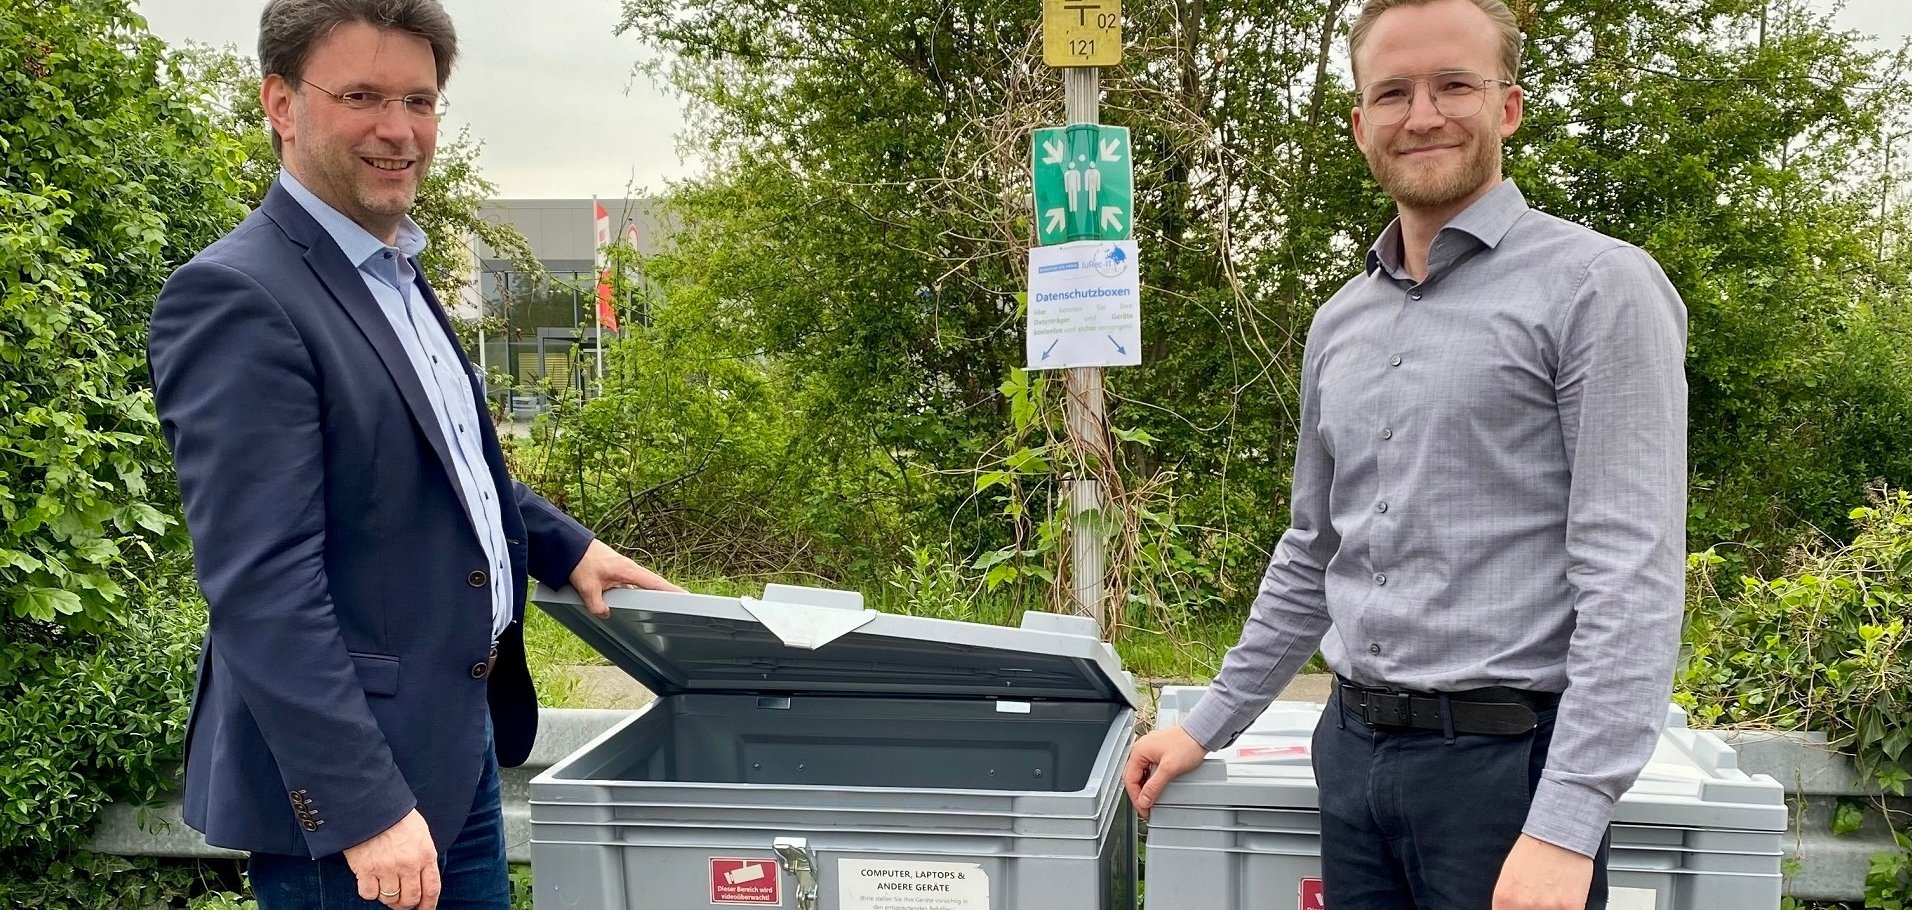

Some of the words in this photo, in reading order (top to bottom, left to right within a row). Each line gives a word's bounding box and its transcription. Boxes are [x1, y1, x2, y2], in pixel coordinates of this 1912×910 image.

[1097, 13, 1116, 29] 02
[1069, 40, 1095, 55] 121
[1036, 287, 1130, 302] Datenschutzboxen
[1034, 327, 1063, 335] kostenlos
[860, 869, 913, 879] COMPUTER,
[915, 871, 955, 879] LAPTOPS
[877, 882, 913, 891] ANDERE
[915, 882, 950, 892] GERÄTE
[721, 893, 770, 901] videoüberwacht!
